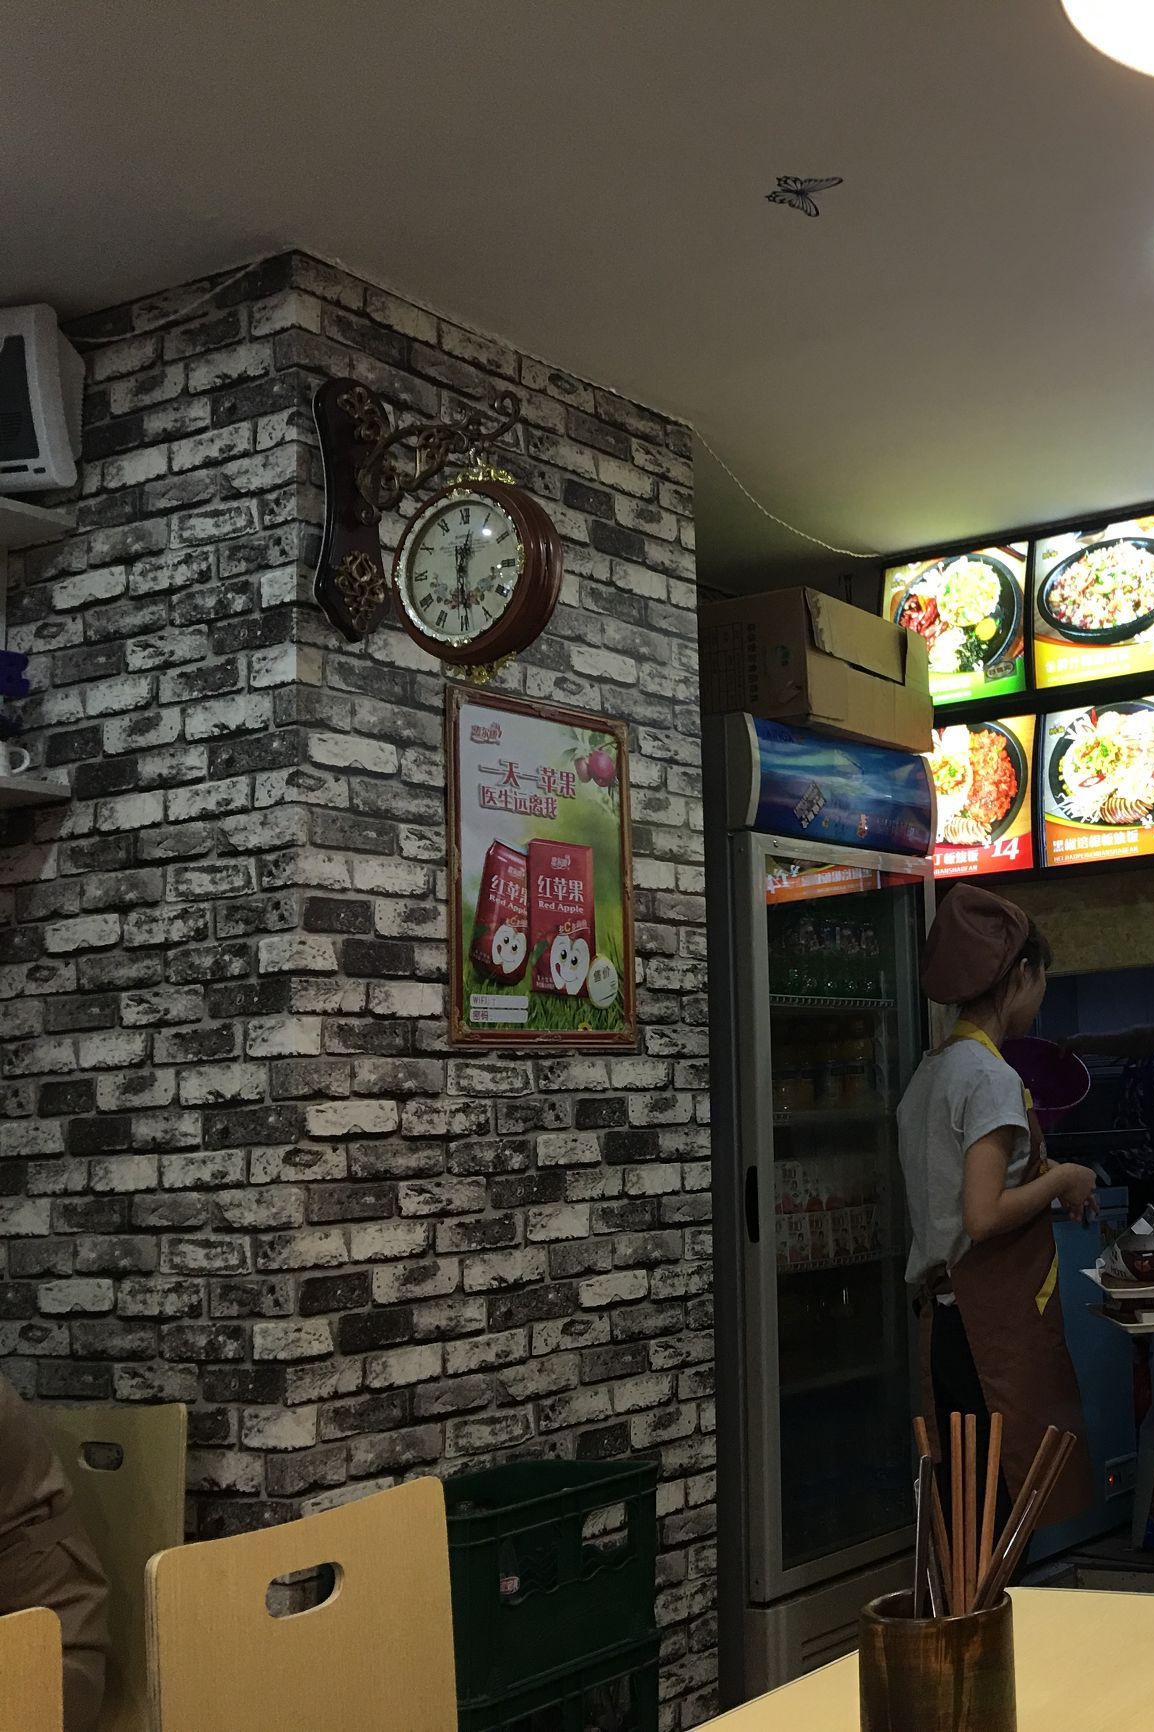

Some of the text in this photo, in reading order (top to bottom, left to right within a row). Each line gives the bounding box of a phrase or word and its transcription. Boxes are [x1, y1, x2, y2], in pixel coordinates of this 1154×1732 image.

[481, 785, 558, 818] 医生远离我
[537, 874, 584, 902] 红苹果
[538, 900, 584, 915] Red Apple
